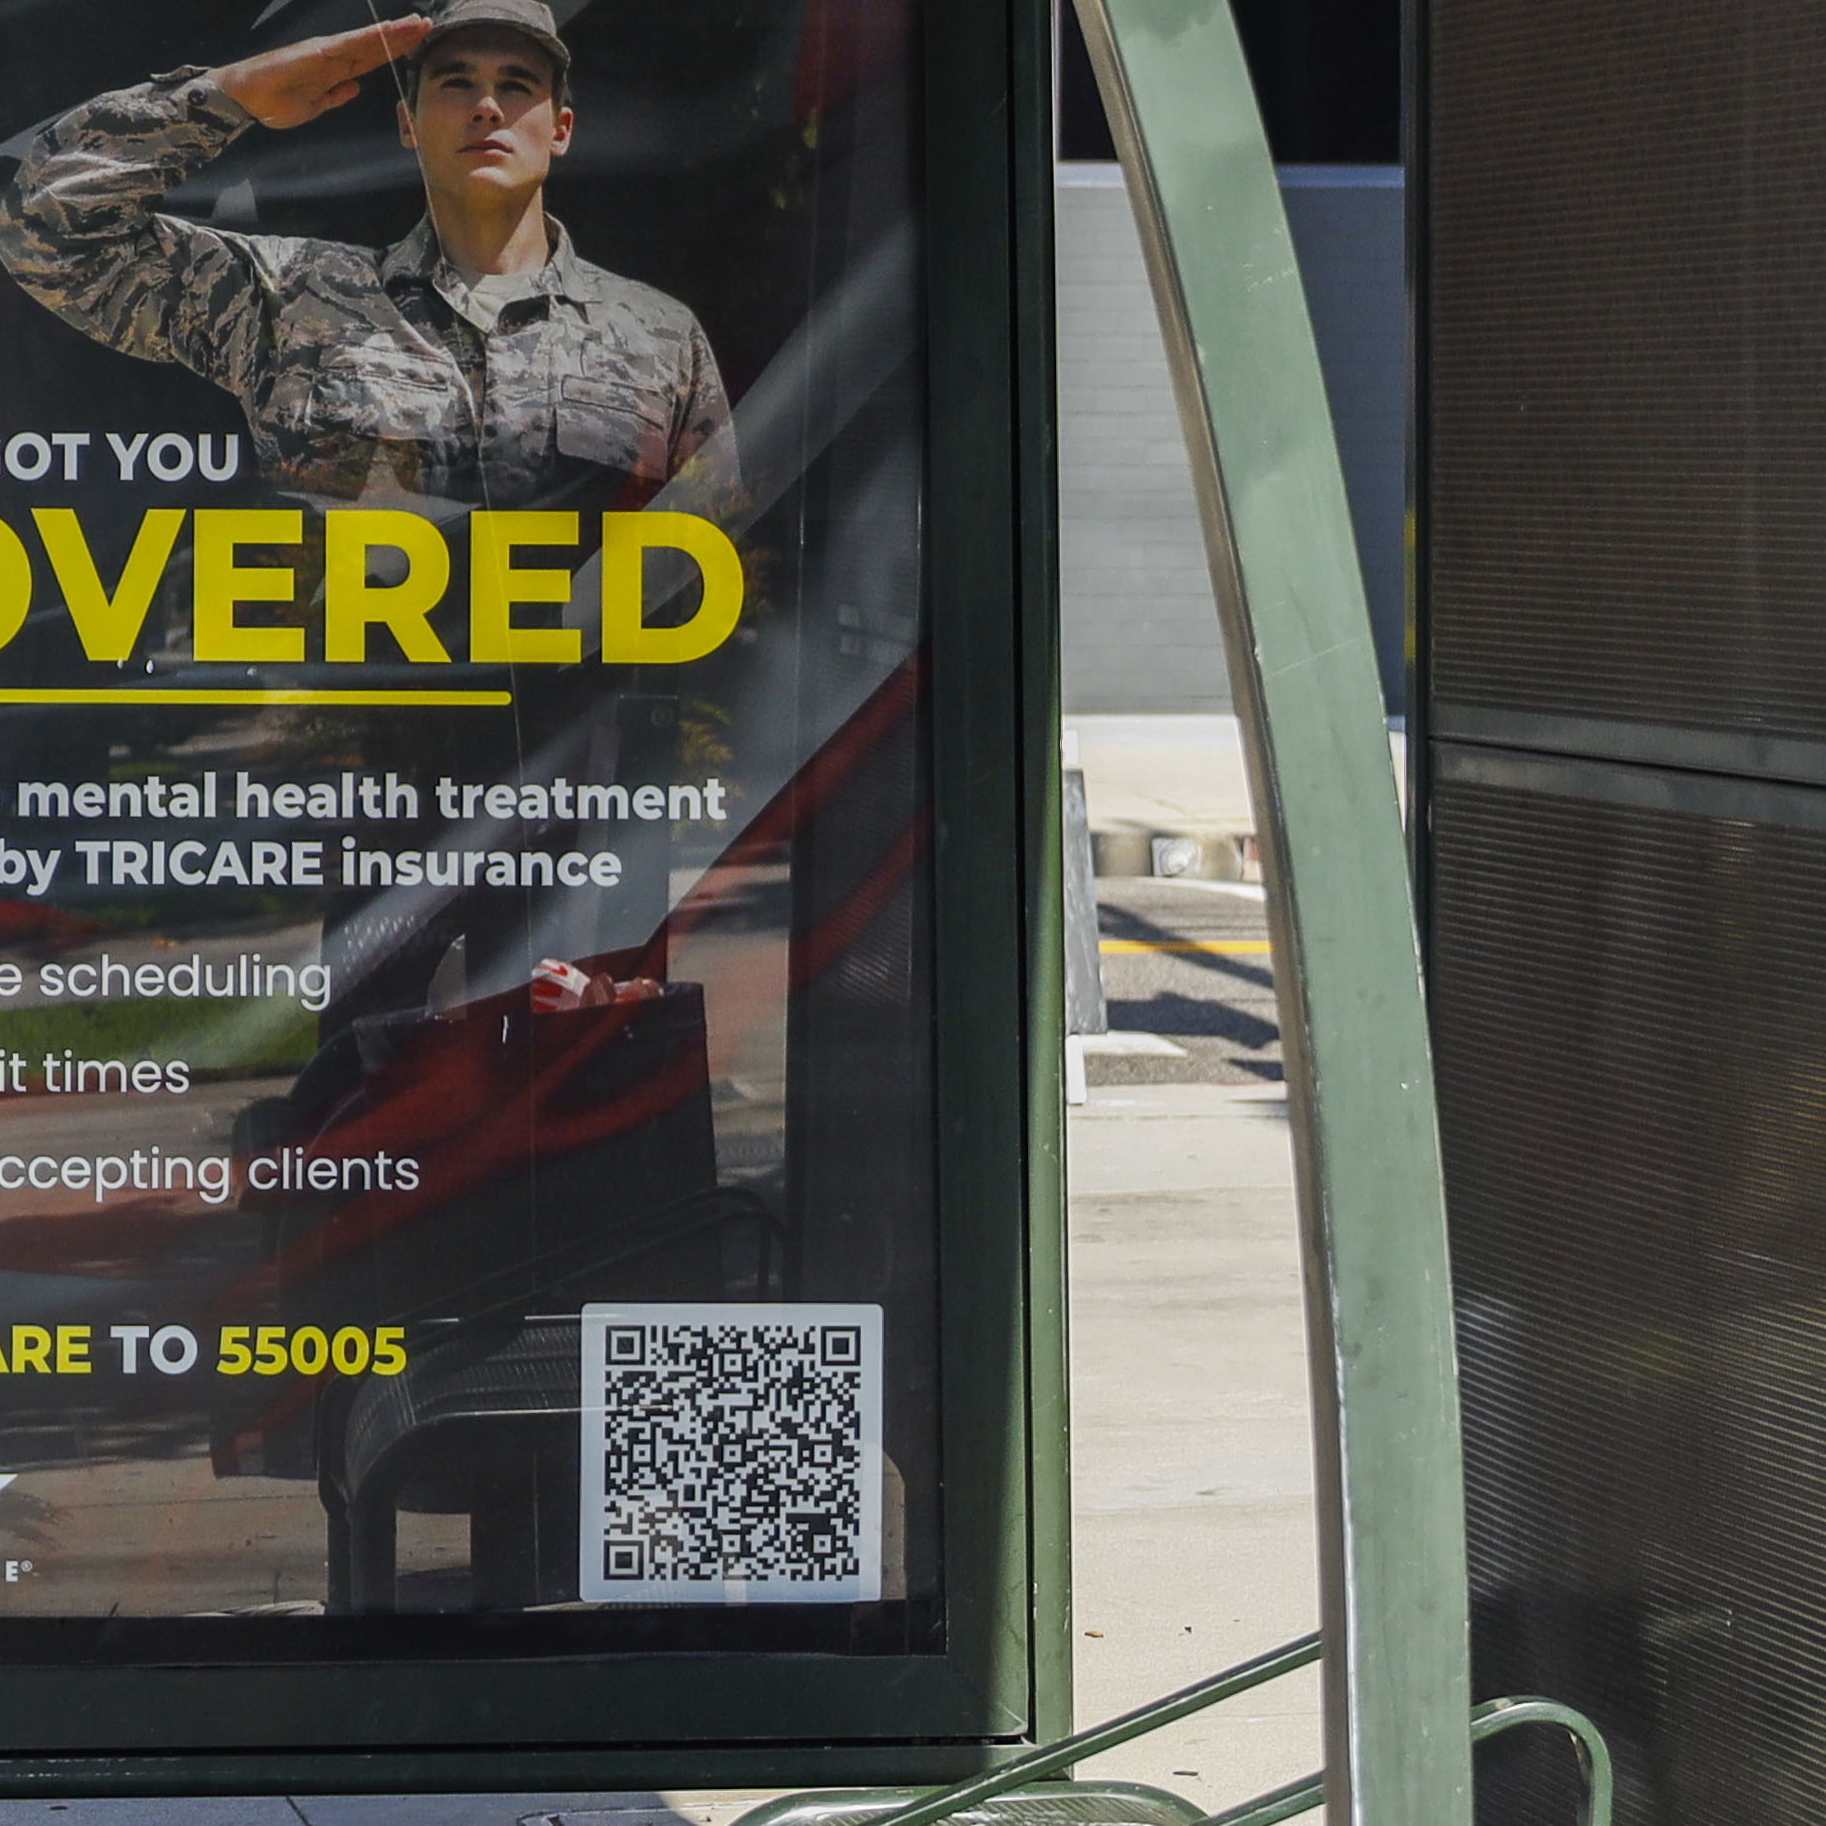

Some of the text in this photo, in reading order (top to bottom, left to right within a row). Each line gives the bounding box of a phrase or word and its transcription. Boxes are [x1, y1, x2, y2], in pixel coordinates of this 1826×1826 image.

[106, 431, 239, 482] YOU
[18, 771, 217, 819] mental
[235, 771, 419, 820] health
[435, 776, 728, 822] treatment
[75, 839, 324, 887] TRICARE
[342, 836, 624, 888] insurance
[39, 951, 331, 1012] scheduling
[42, 1049, 191, 1095] times
[247, 1145, 421, 1192] clients
[110, 1324, 198, 1376] TO
[215, 1325, 408, 1377] 55005
